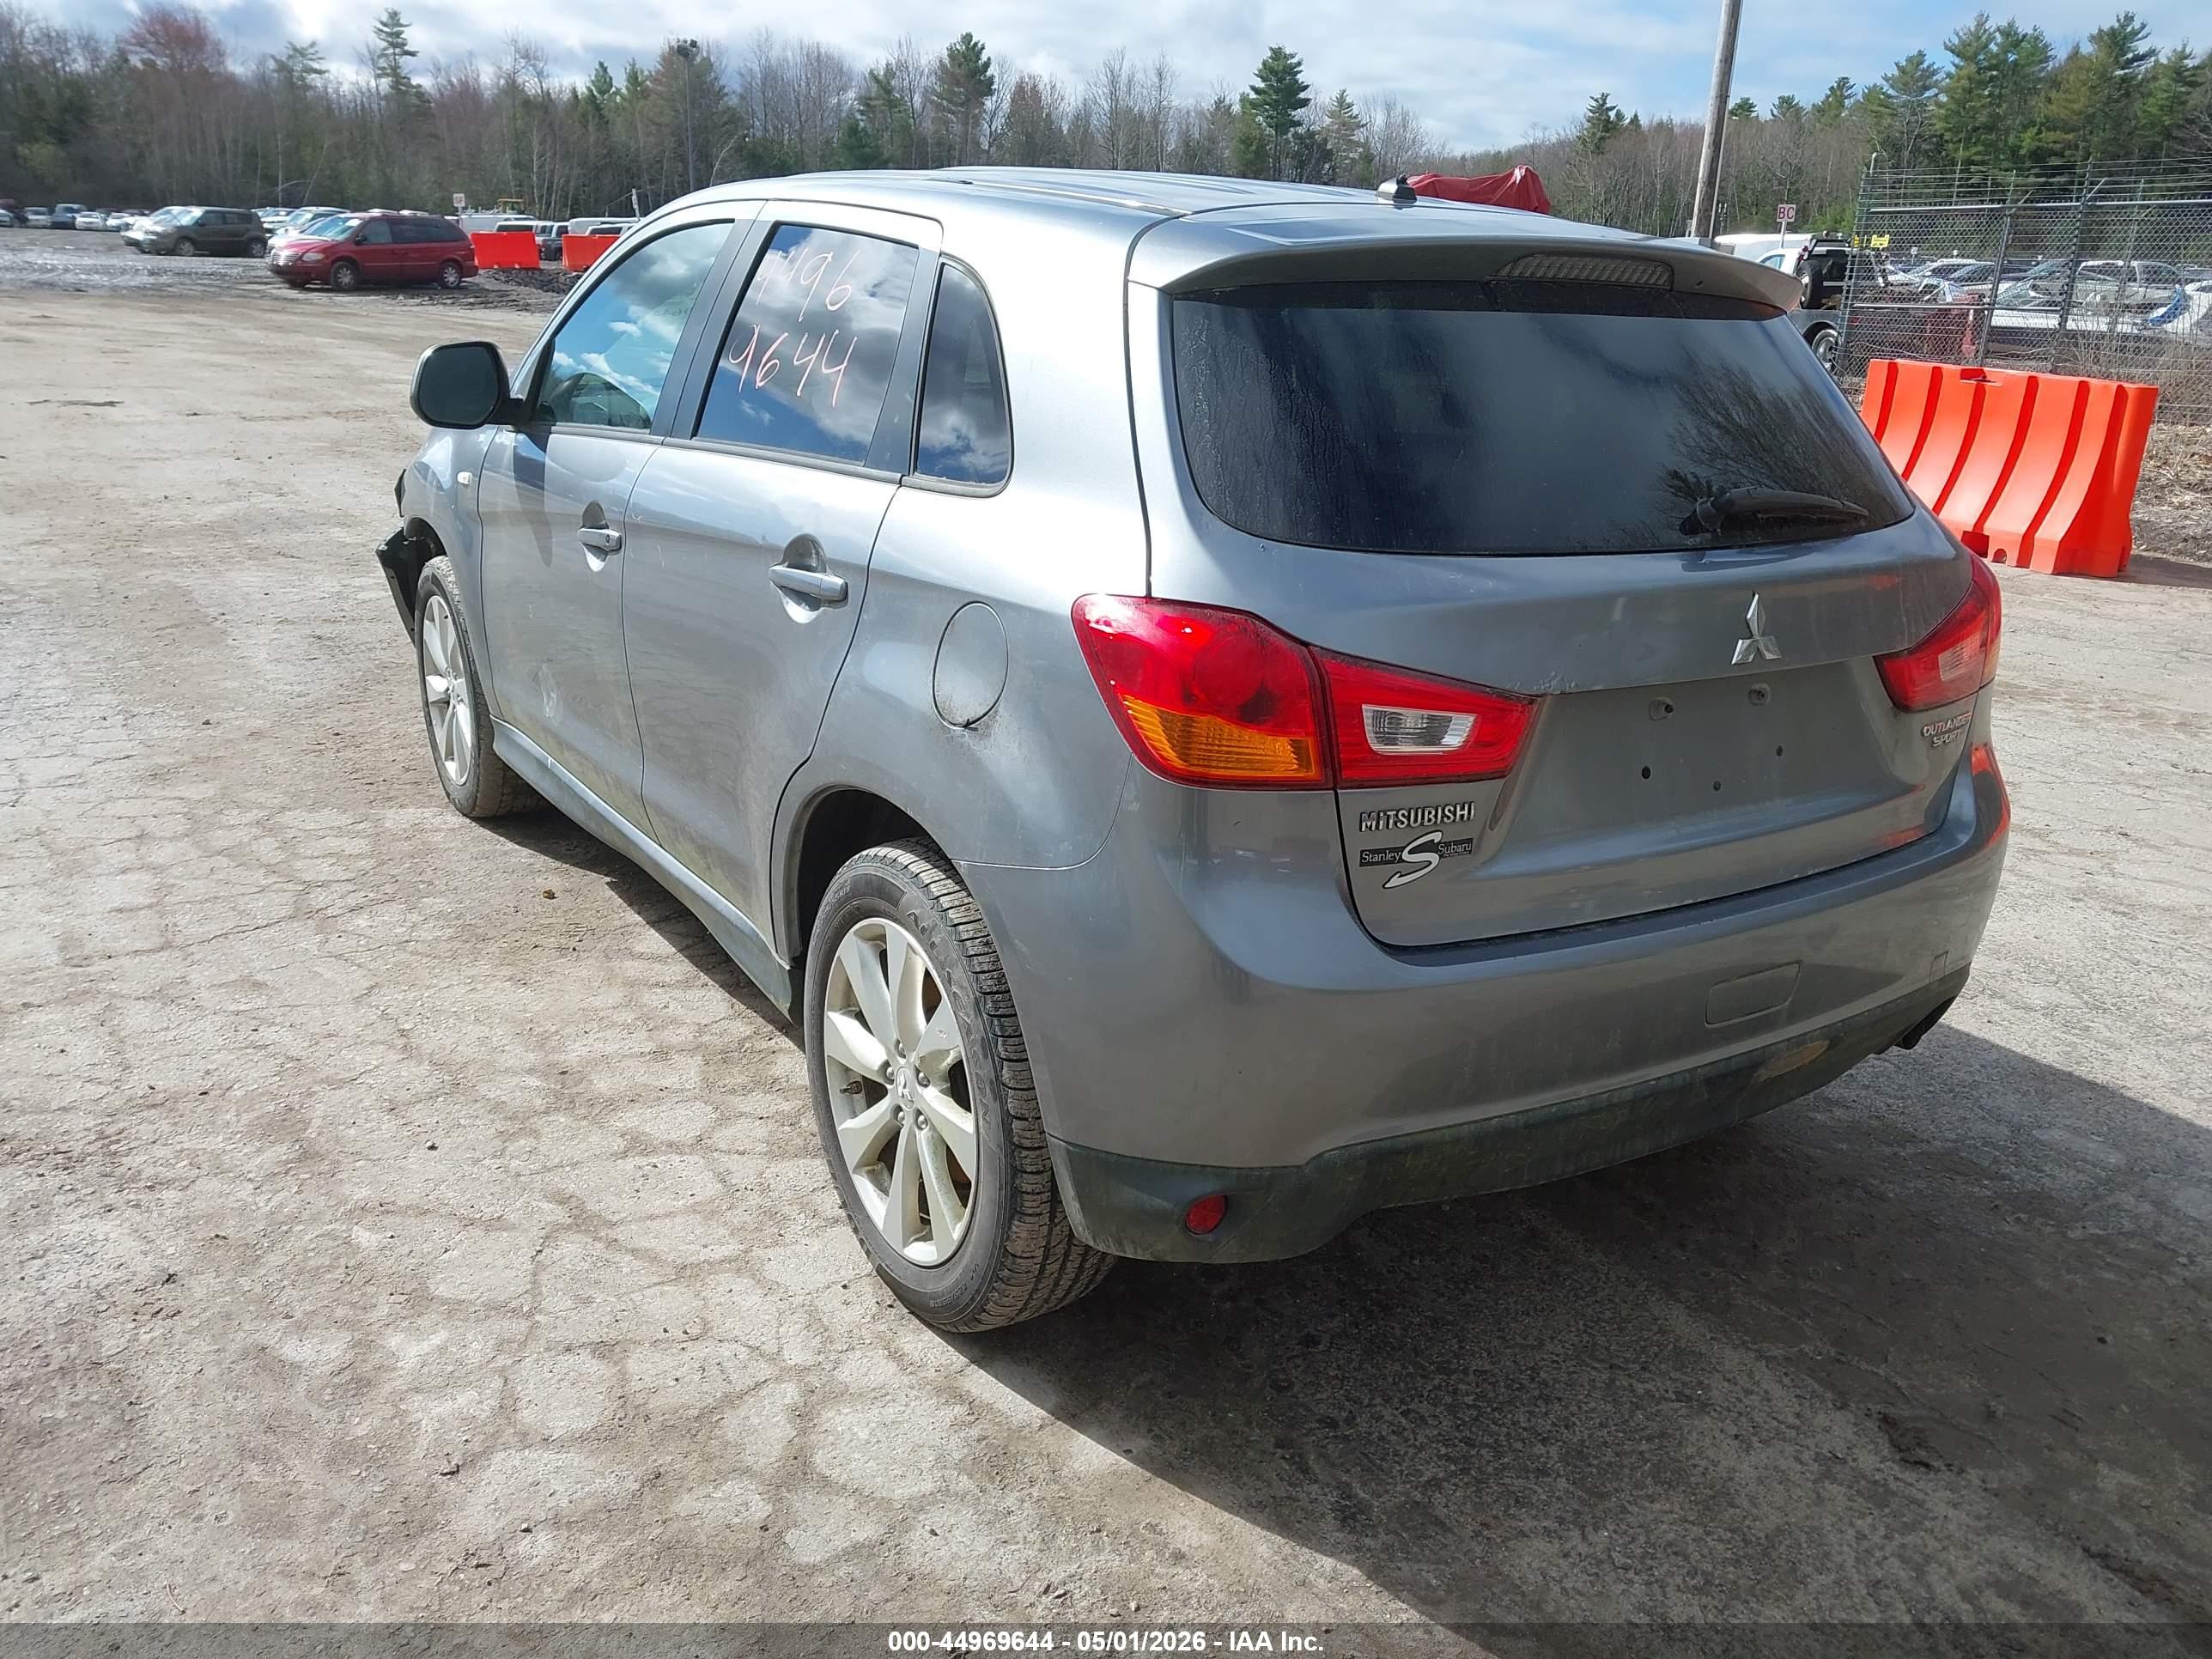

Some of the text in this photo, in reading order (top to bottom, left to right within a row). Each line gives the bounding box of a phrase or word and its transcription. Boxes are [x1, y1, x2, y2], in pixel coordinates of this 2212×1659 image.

[1778, 206, 1795, 220] BC
[729, 324, 858, 408] 9644
[1922, 711, 1972, 737] OUTLANDER
[1932, 729, 1963, 747] SPORT
[1360, 801, 1475, 831] MITSUBISHI
[1361, 848, 1403, 863] Stanley
[1437, 842, 1472, 855] Subaru
